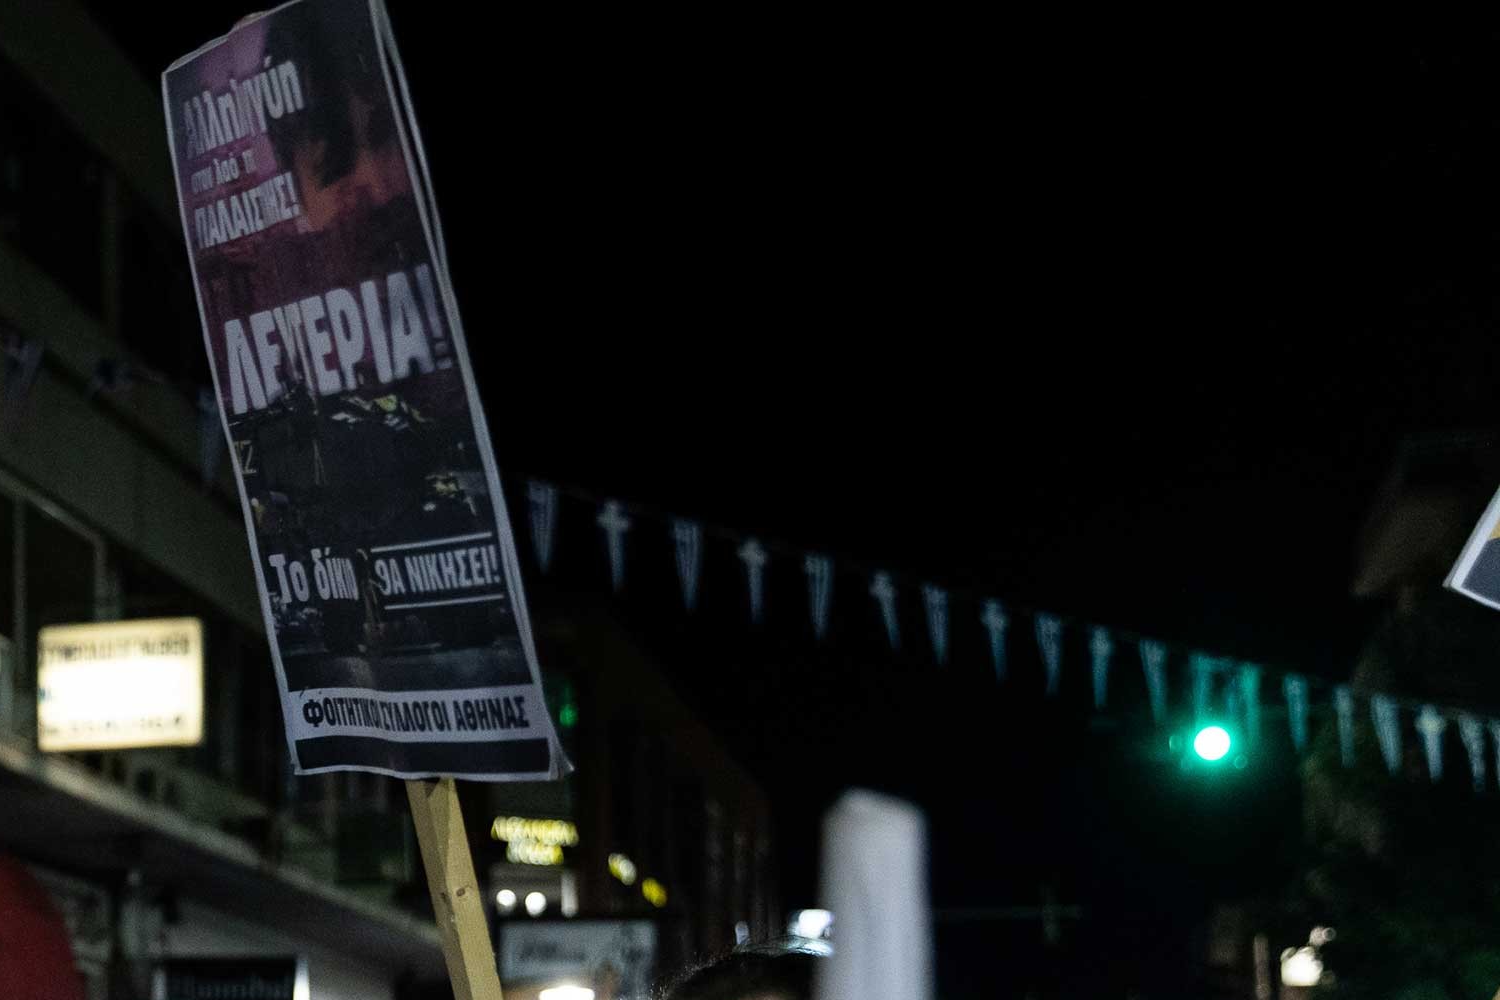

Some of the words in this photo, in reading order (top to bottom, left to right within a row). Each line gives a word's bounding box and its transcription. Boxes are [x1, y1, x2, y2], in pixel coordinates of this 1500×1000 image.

[268, 553, 310, 604] Το
[405, 545, 501, 593] ΝΙΚΗΣΕΙ!
[454, 695, 530, 731] ΑΘΗΝΑΣ
